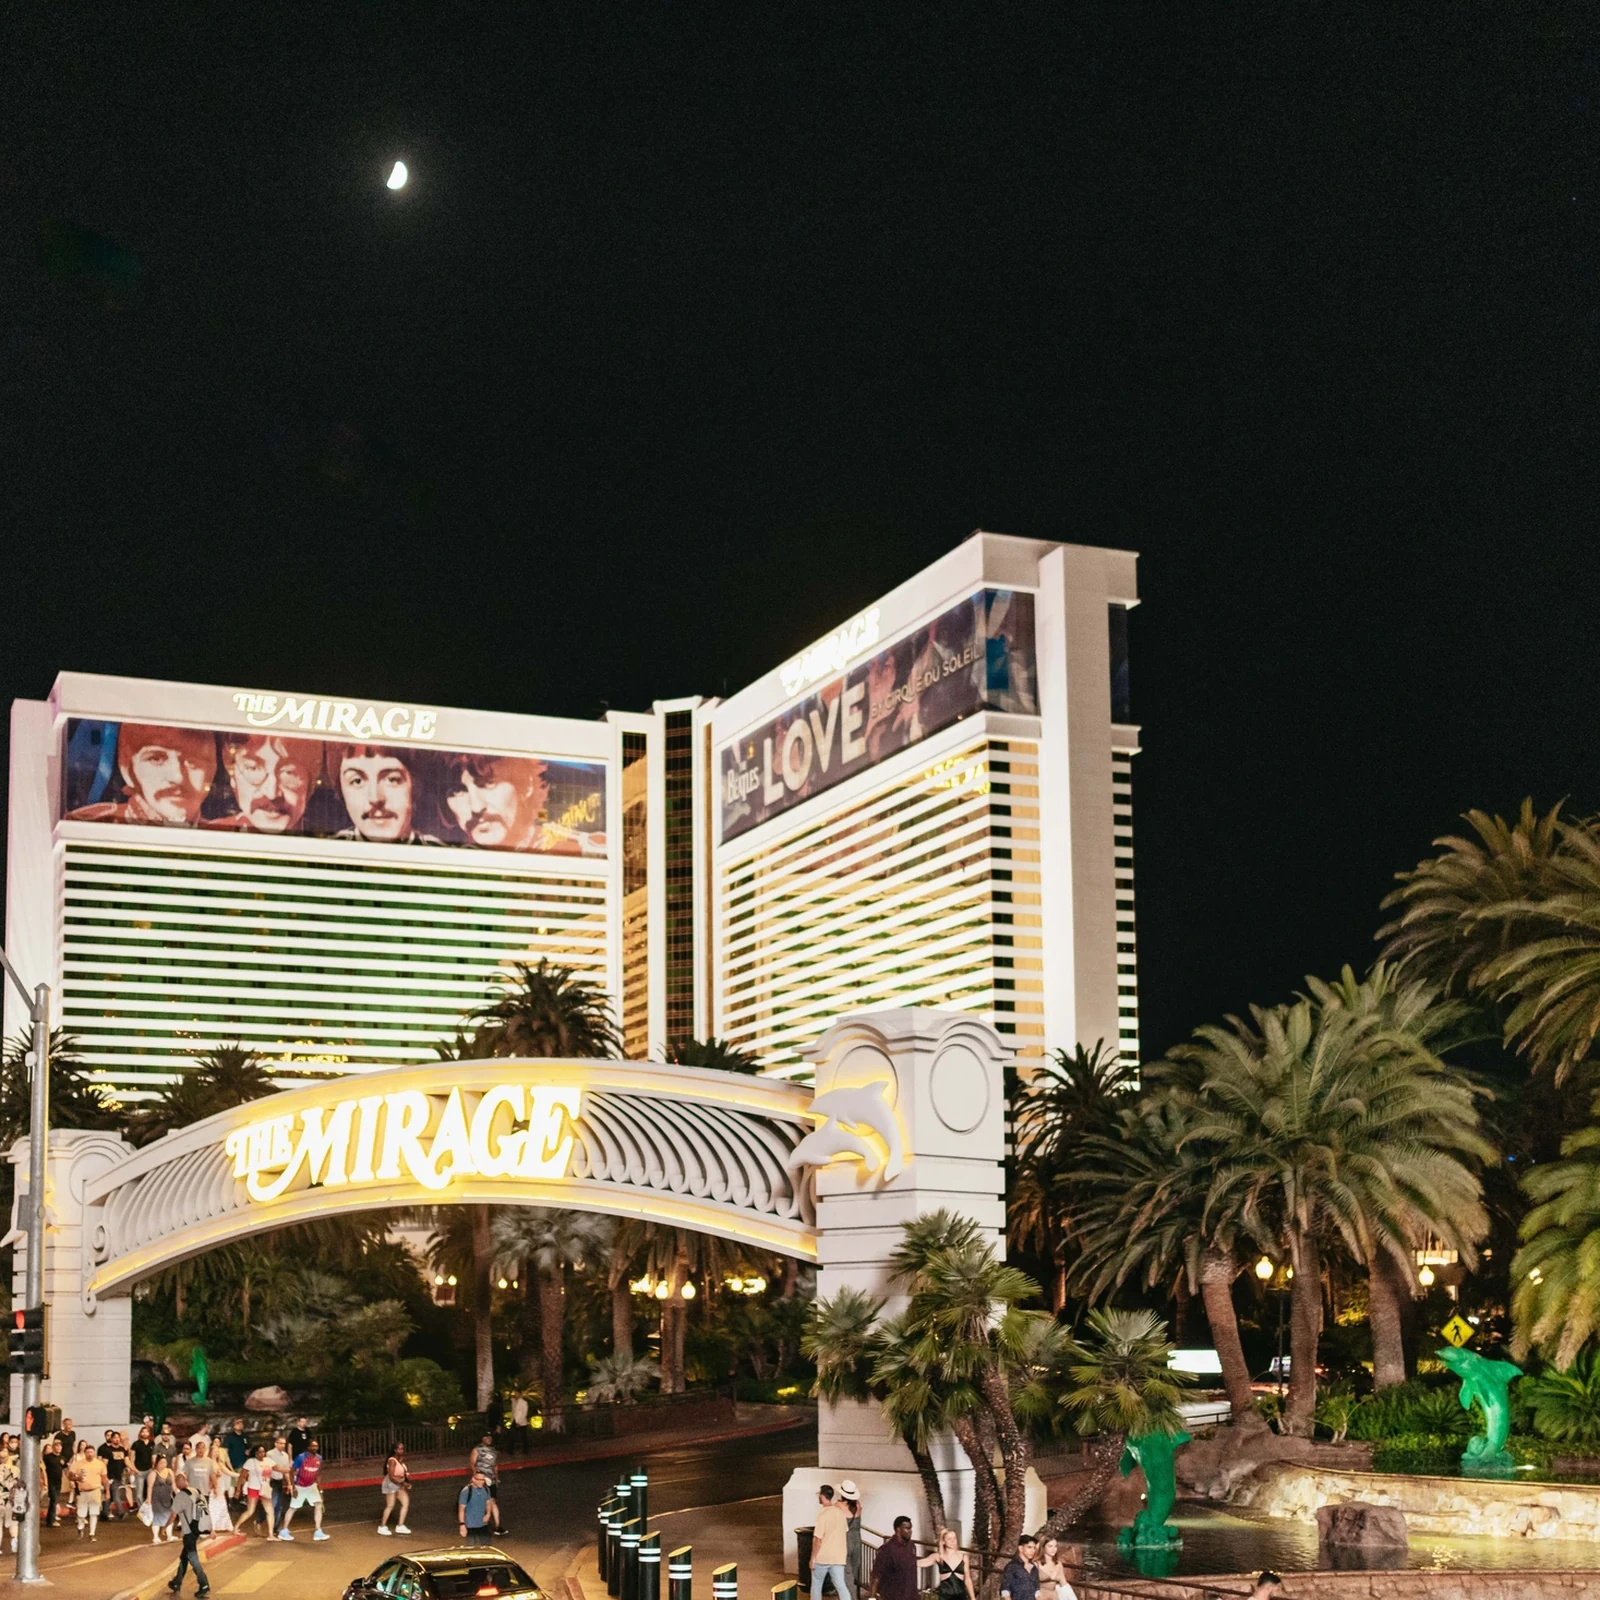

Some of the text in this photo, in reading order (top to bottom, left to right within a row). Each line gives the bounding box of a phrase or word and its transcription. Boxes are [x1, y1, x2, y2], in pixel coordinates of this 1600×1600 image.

[233, 693, 438, 740] THE MIRAGE
[884, 677, 922, 709] CIRQUE
[925, 665, 940, 687] DU
[943, 644, 981, 677] SOLEIL
[763, 681, 866, 806] LOVE
[225, 1084, 582, 1202] THE MIRAGE
